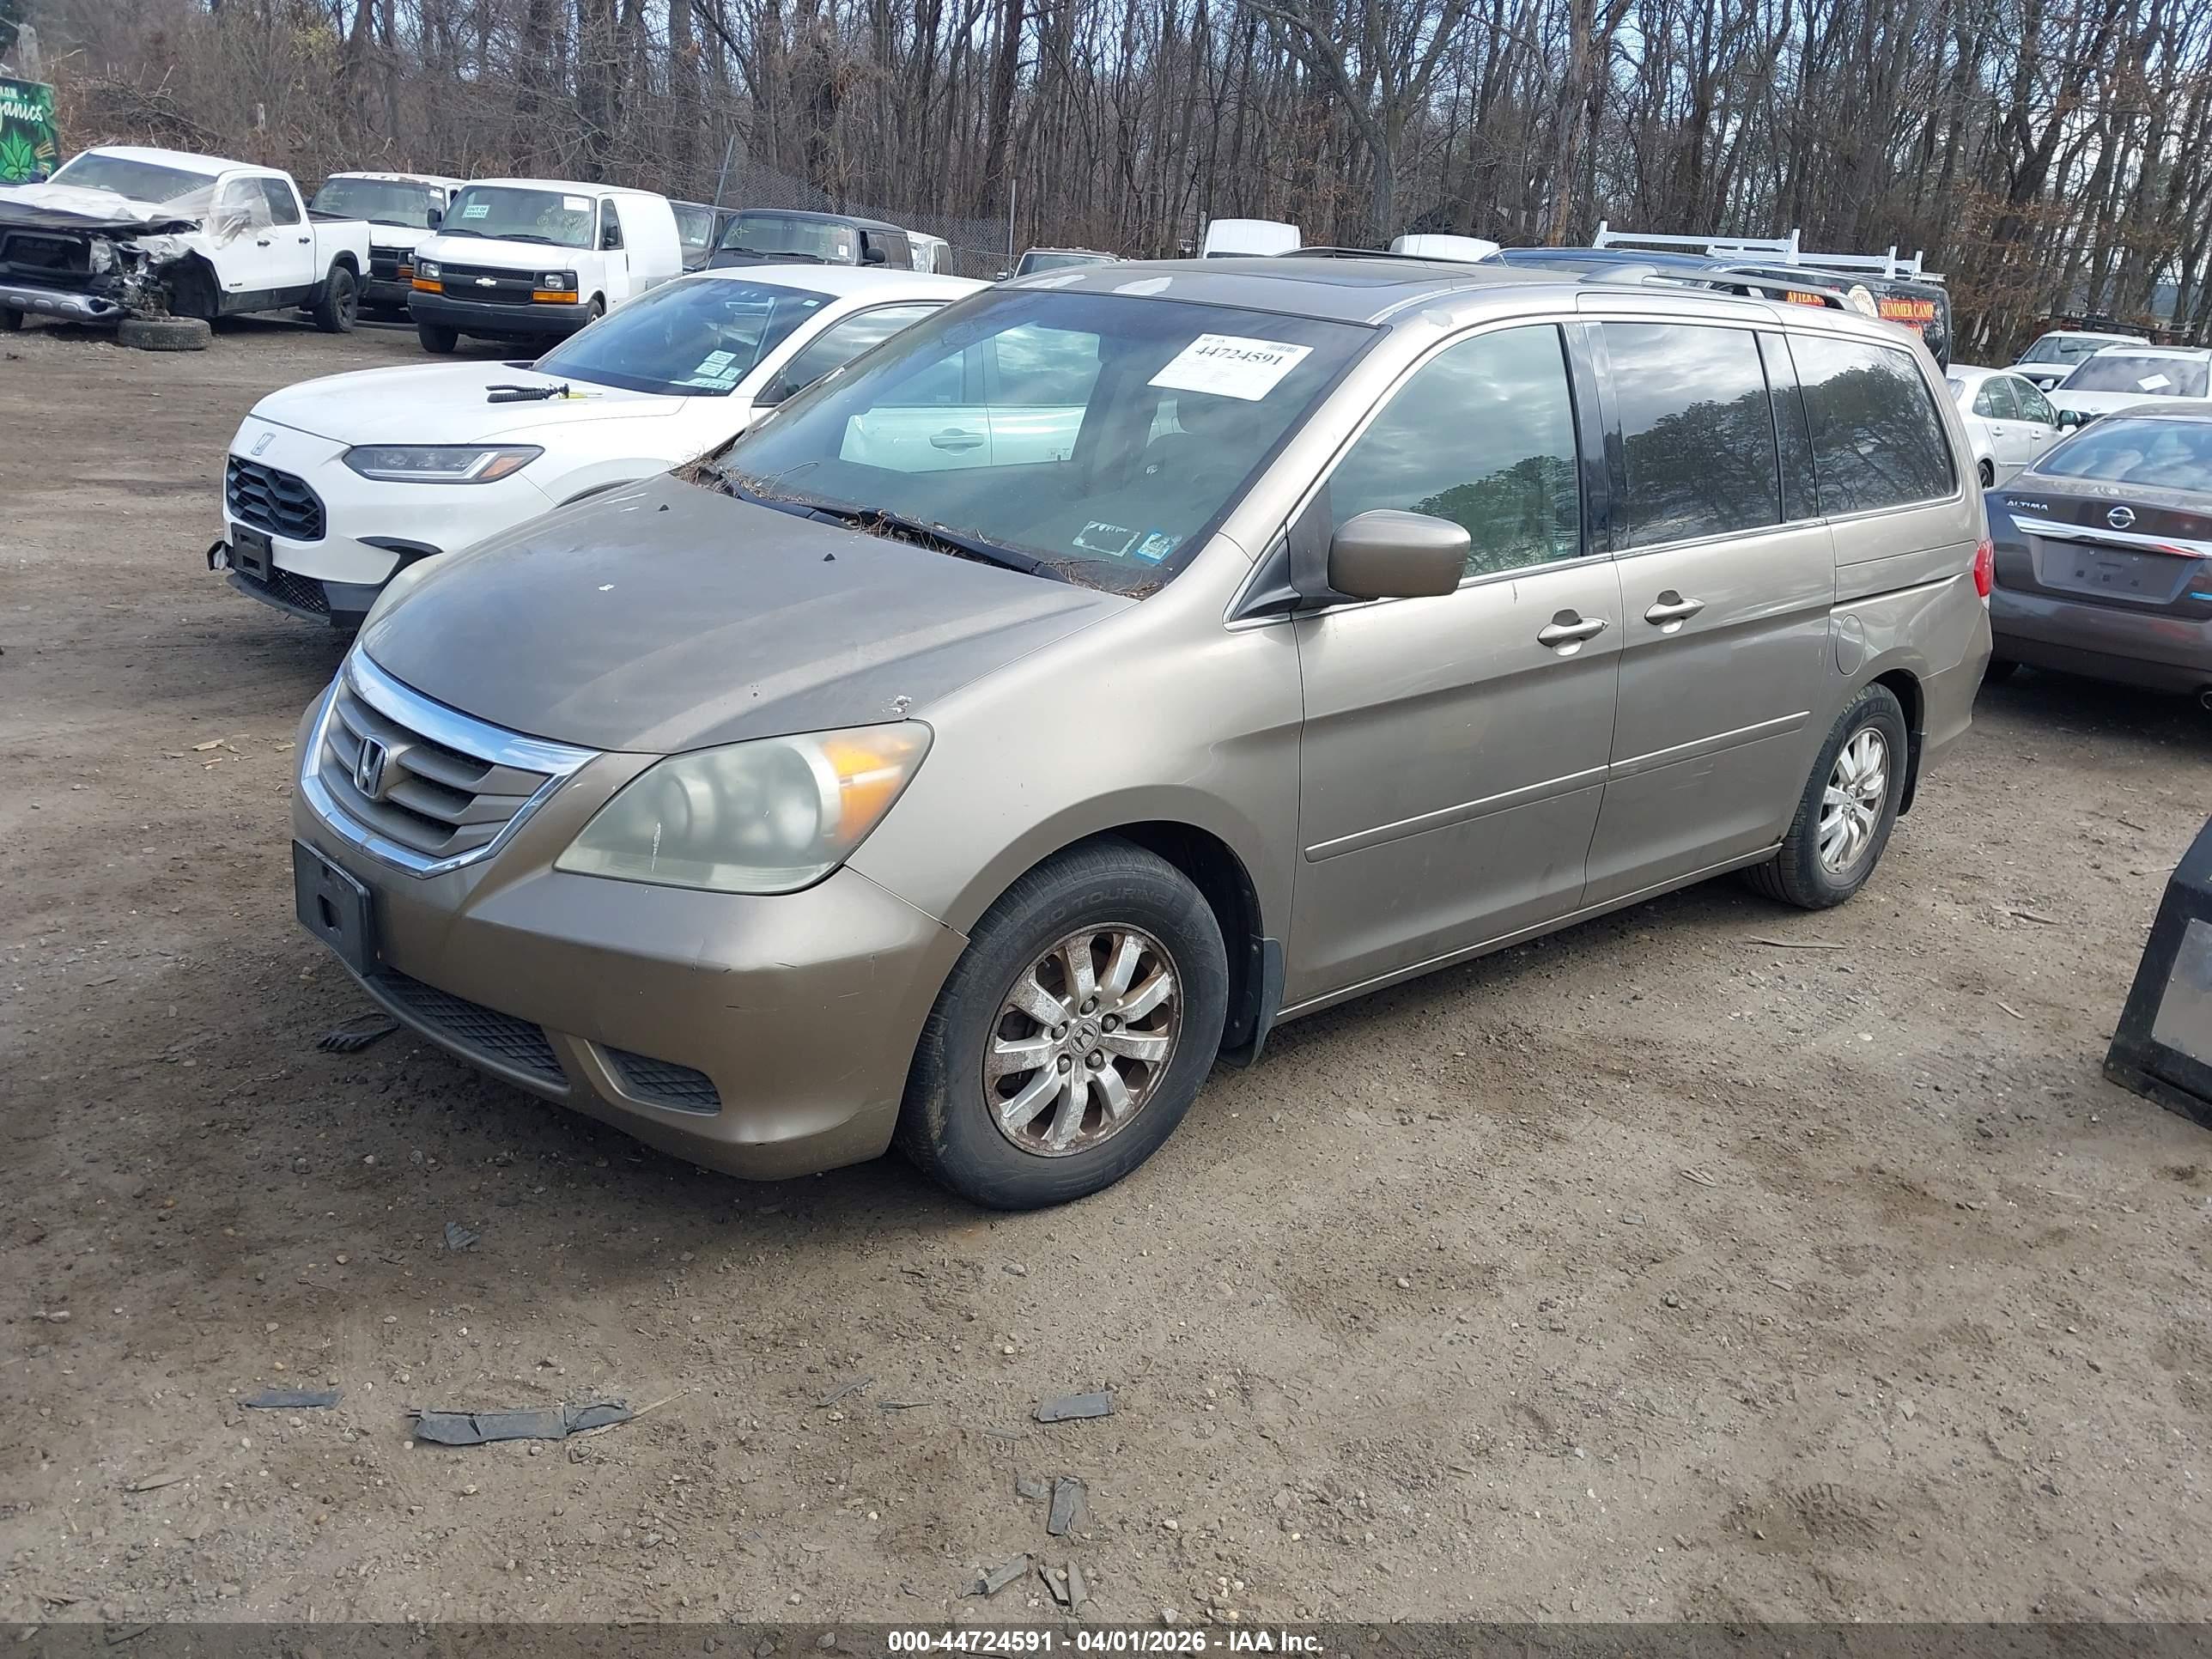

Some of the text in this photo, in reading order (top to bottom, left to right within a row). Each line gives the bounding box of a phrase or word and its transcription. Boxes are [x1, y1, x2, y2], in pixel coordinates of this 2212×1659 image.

[1881, 302, 1913, 317] SUMMER
[1913, 303, 1935, 318] CAMP
[1194, 345, 1285, 366] 44724591
[2007, 500, 2049, 512] ALTIMA
